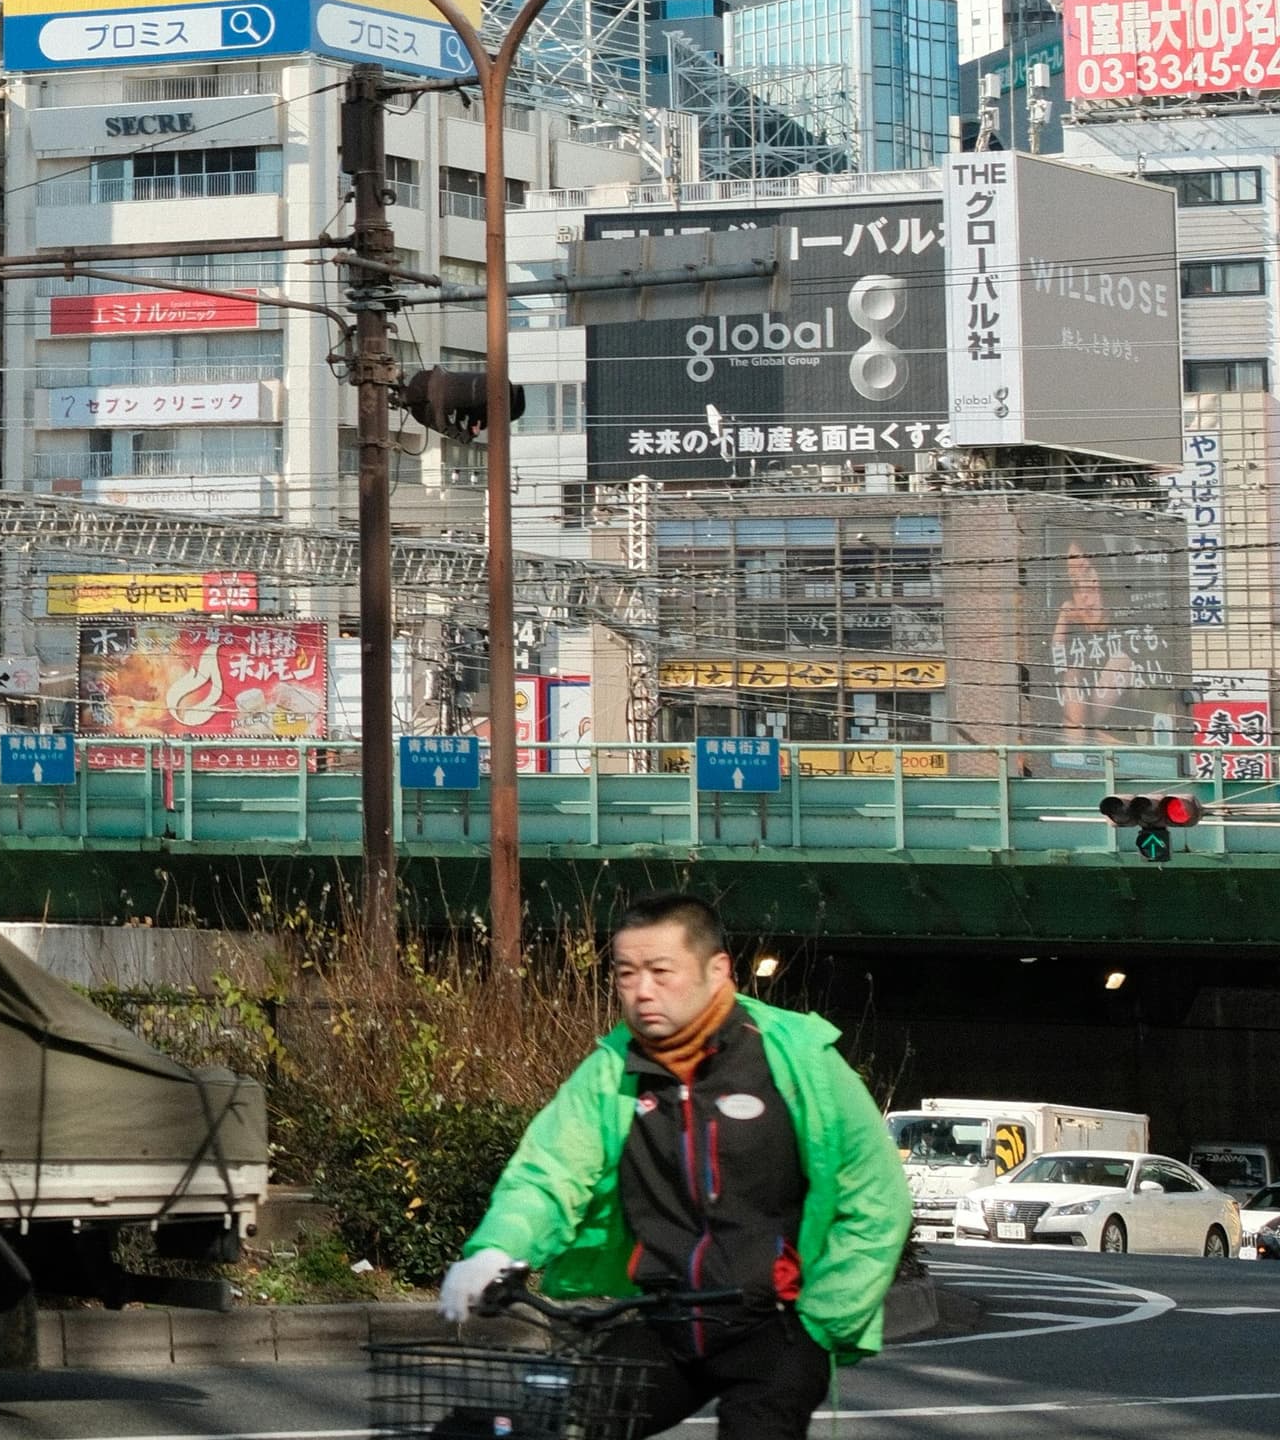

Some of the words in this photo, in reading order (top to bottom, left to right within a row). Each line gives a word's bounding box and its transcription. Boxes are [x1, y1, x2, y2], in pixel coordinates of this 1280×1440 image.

[84, 22, 190, 52] プロミス
[347, 19, 421, 56] プロミス
[104, 112, 196, 137] SECRE
[952, 162, 1007, 186] THE
[965, 190, 1002, 361] グローバル社
[1029, 255, 1169, 318] WILLROSE
[685, 307, 835, 382] global
[730, 356, 749, 367] The
[751, 356, 786, 367] Global
[787, 356, 820, 369] Group
[86, 399, 139, 414] セブン
[153, 393, 243, 412] クリニック
[954, 394, 991, 413] global
[1191, 434, 1222, 624] やっぱりカラ鉄
[1052, 624, 1169, 673] 自分本位でも、
[229, 652, 316, 682] ホルモン
[1194, 709, 1269, 747] 寿司
[407, 739, 471, 755] 青梅街道
[705, 740, 771, 757] 青梅街道
